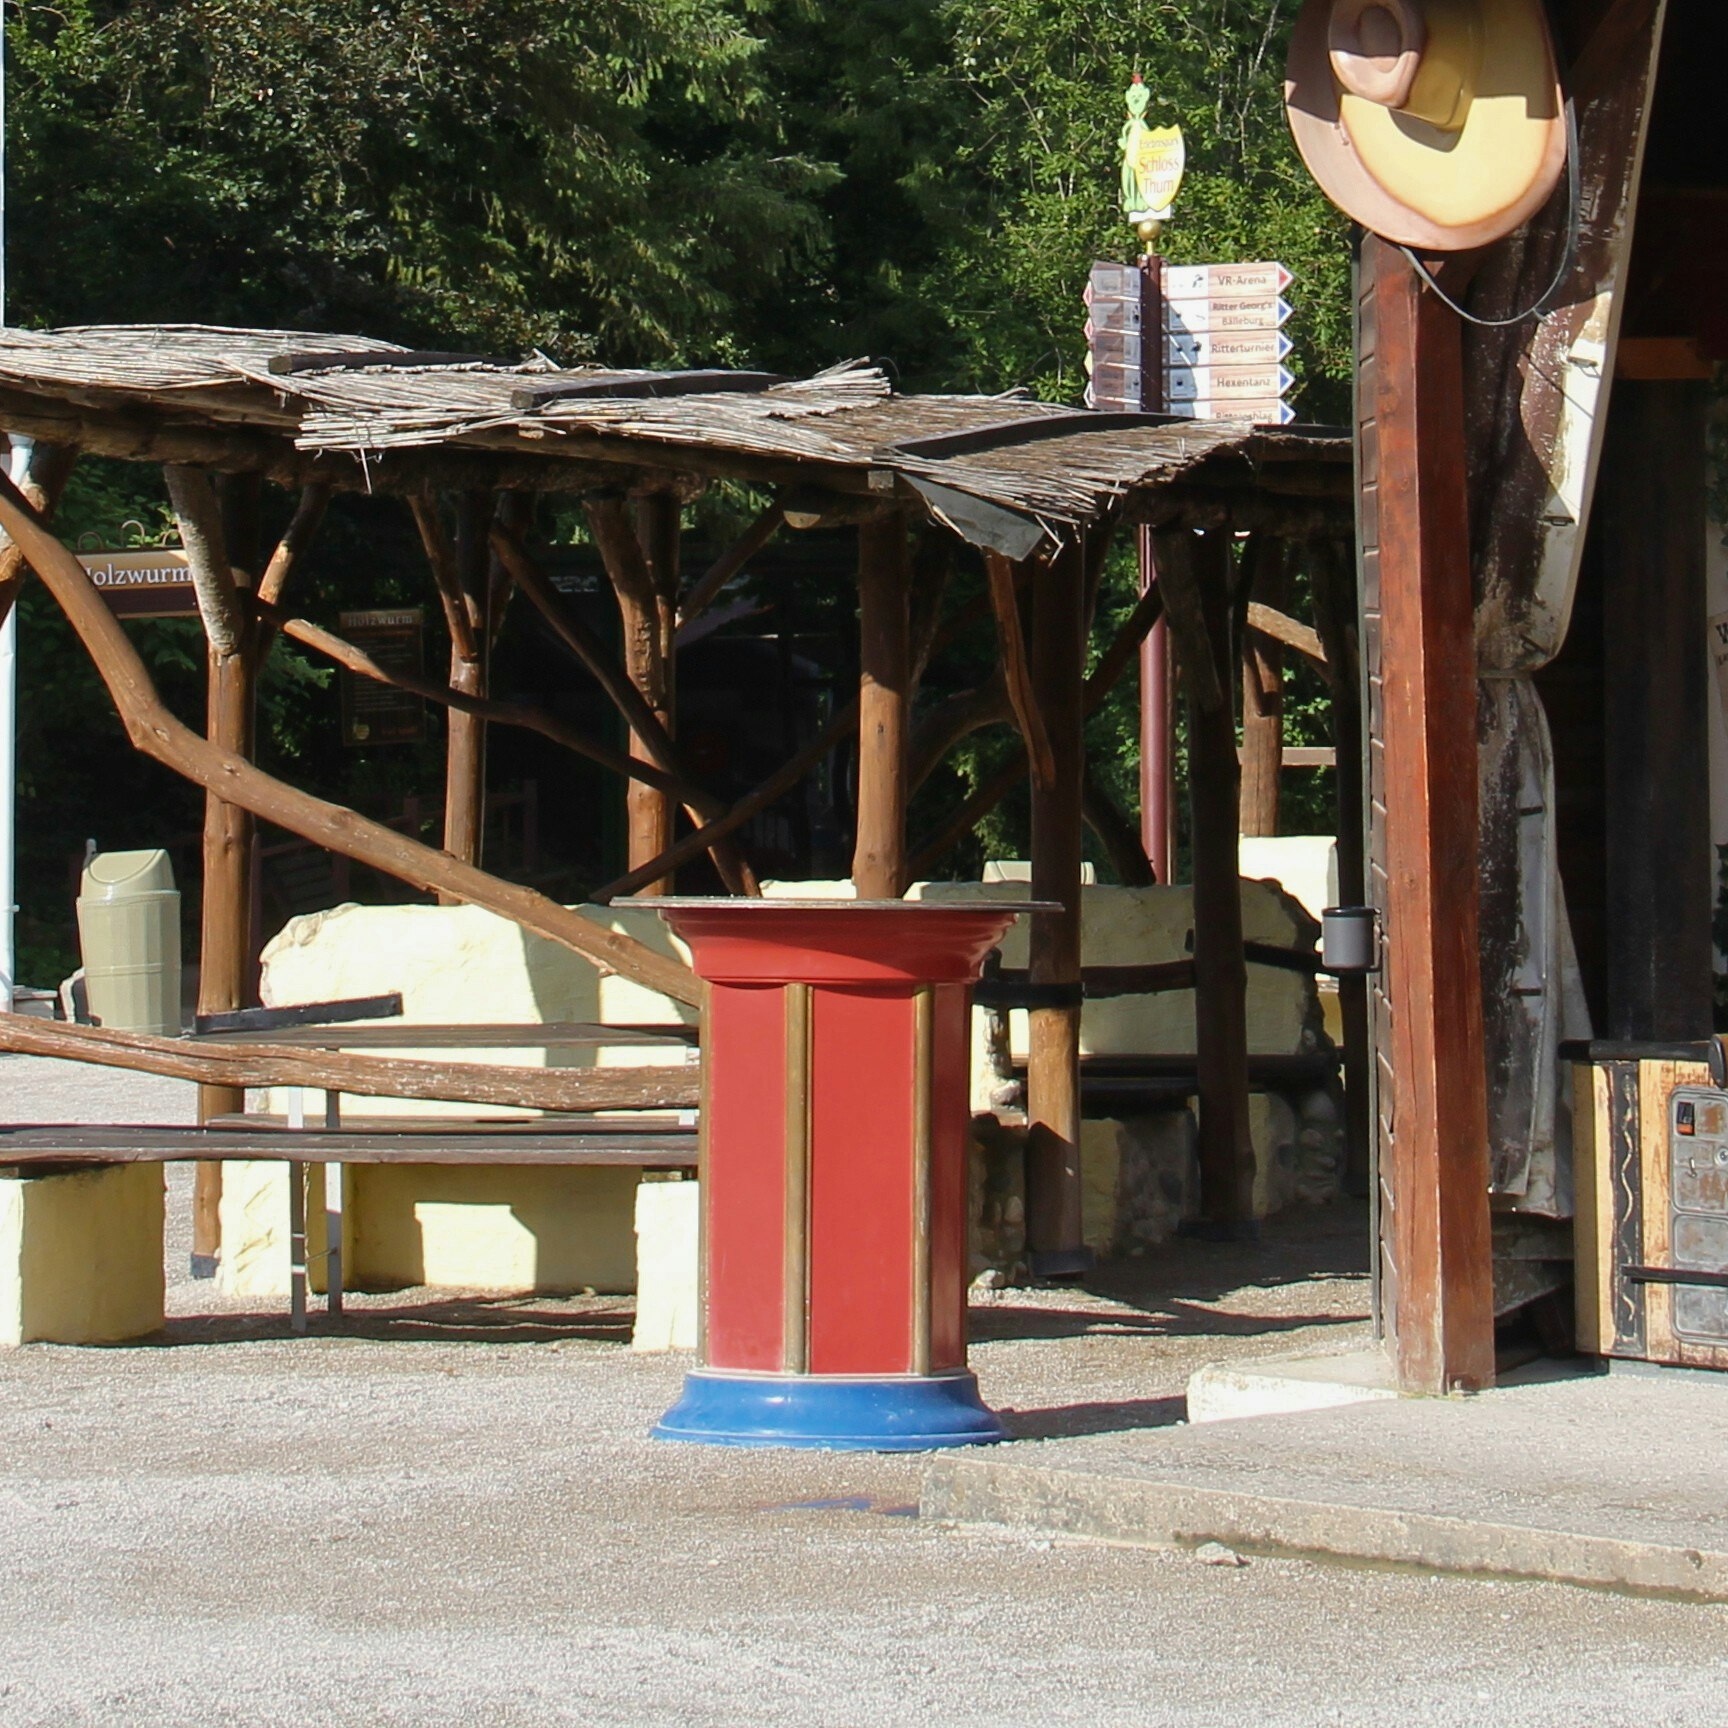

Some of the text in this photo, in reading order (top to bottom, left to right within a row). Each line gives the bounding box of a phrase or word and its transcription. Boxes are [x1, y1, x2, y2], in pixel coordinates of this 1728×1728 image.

[1139, 155, 1180, 174] Schloss
[1144, 178, 1174, 194] Thum
[1217, 275, 1267, 286] VR-Arena
[1212, 302, 1237, 311] Ritter
[1211, 343, 1275, 354] Ritterturnier
[1216, 376, 1271, 388] Hexentanz
